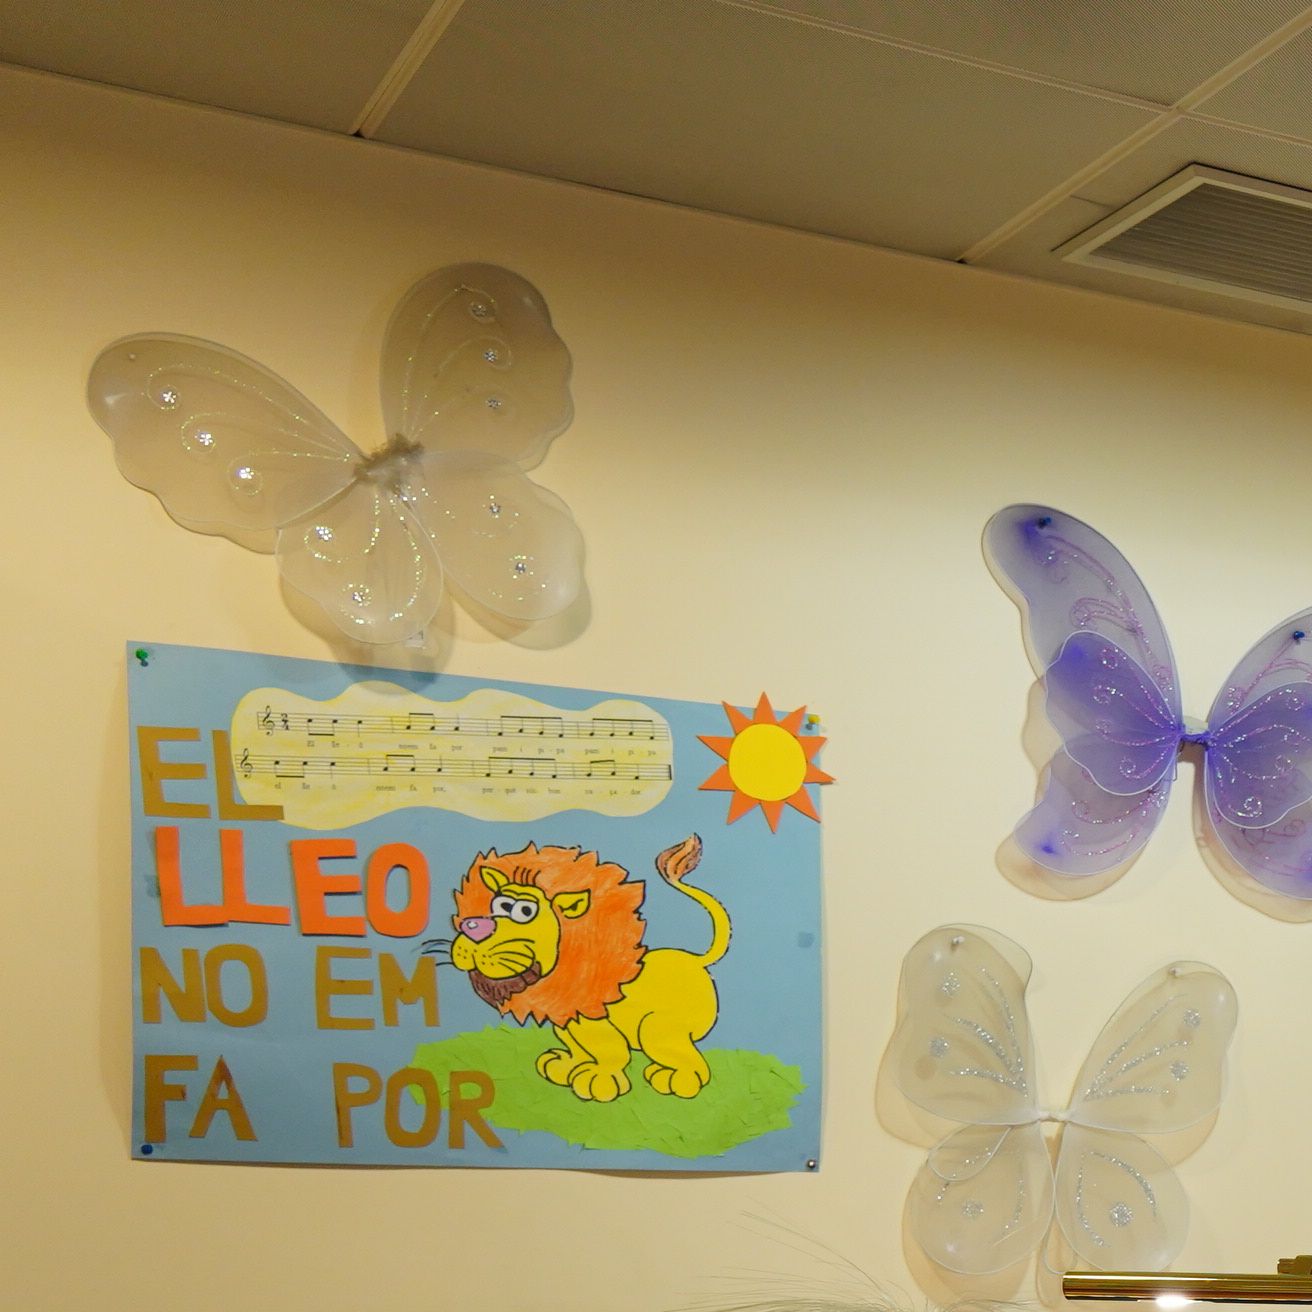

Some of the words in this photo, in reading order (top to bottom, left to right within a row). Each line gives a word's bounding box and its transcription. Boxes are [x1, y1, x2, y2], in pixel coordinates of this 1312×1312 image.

[136, 726, 285, 821] EL
[154, 825, 431, 938] LLEO
[138, 944, 270, 1028] NO
[313, 945, 441, 1030] EM
[143, 1054, 259, 1145] FA
[331, 1061, 508, 1150] POR
